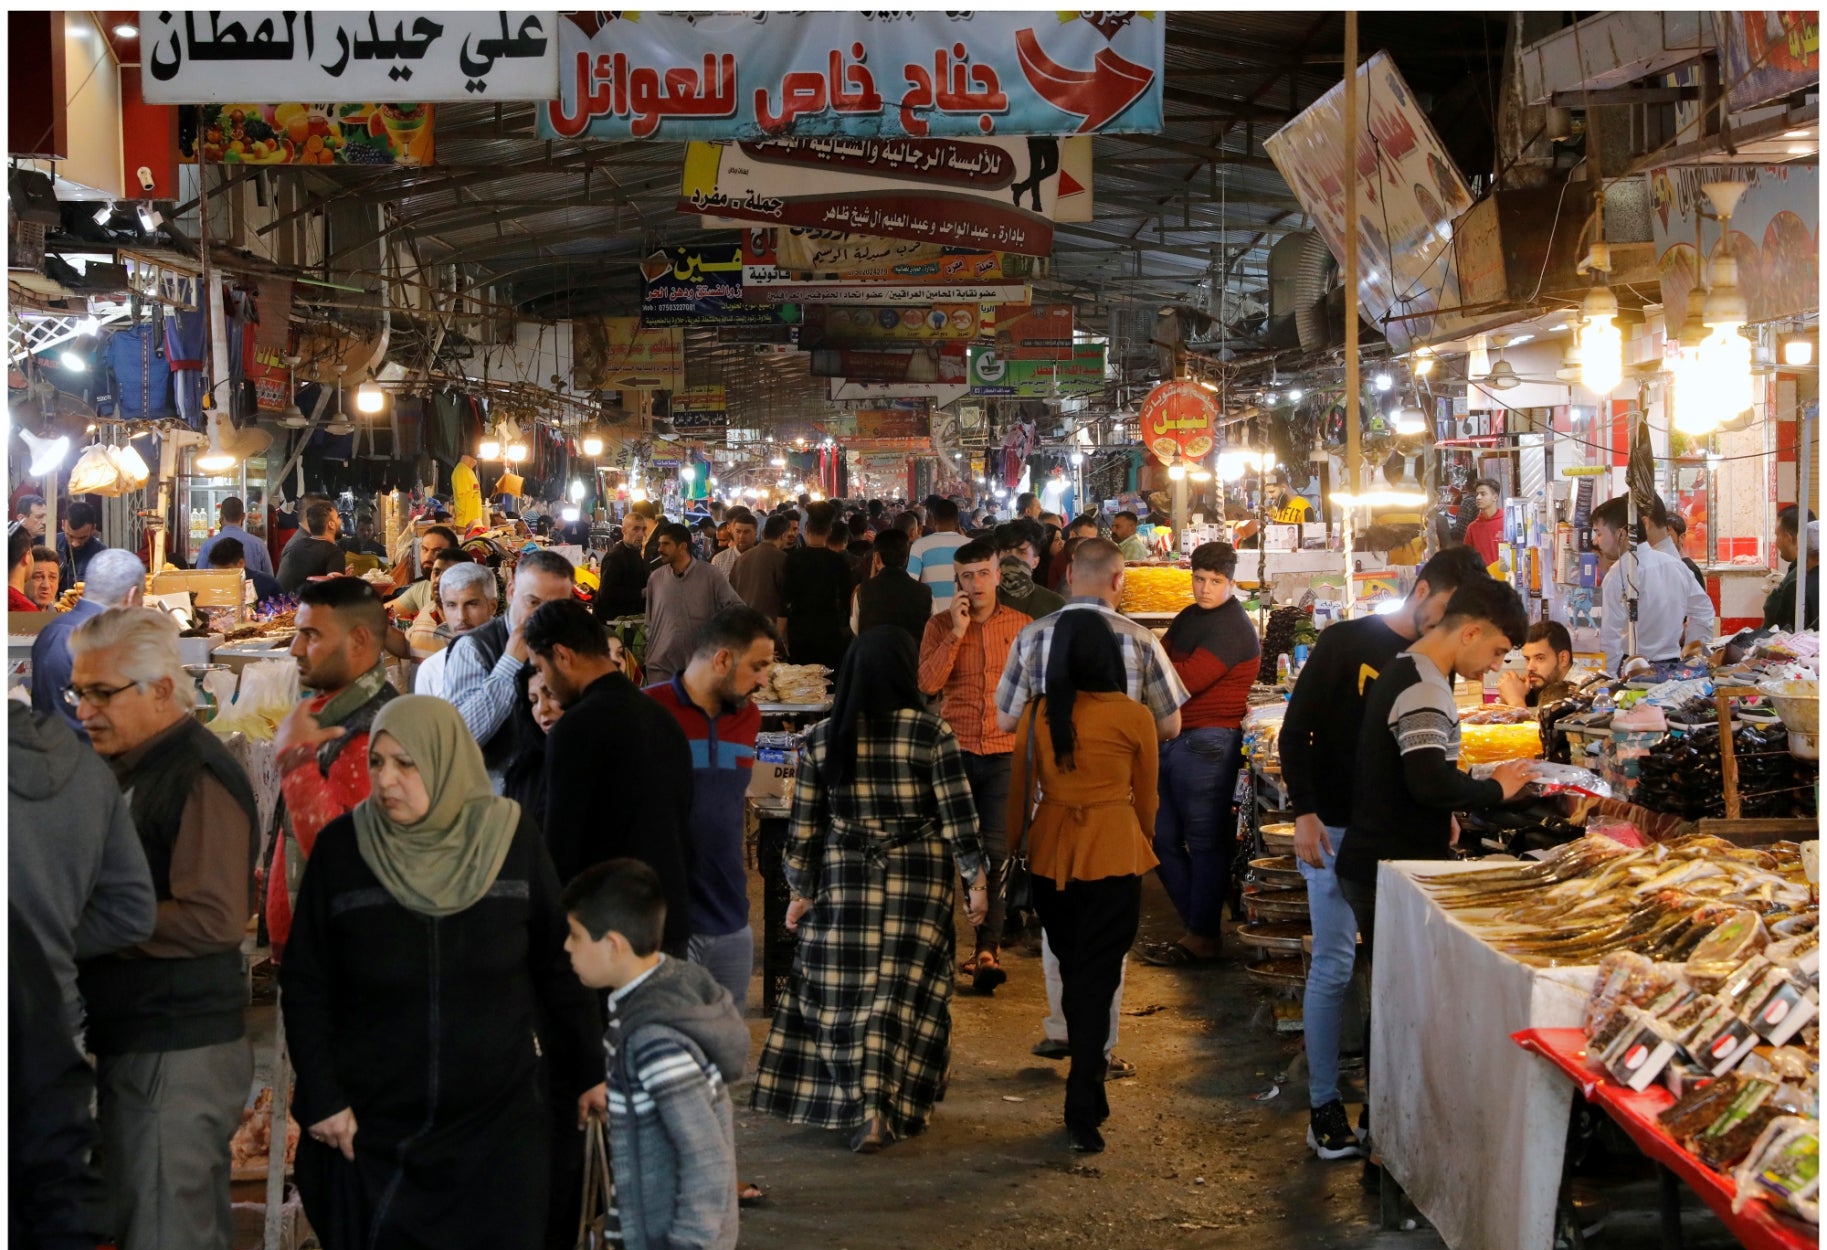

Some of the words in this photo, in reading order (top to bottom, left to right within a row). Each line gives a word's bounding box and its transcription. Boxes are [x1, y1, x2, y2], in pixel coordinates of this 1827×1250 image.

[321, 11, 443, 81] حيدر
[460, 11, 547, 93] علي
[549, 51, 736, 137] للعوائل
[753, 42, 882, 136] خاص
[900, 42, 1007, 134] جناح
[882, 143, 944, 169] الرجالية
[948, 149, 1002, 175] للألبسة
[691, 187, 728, 208] مفرد
[745, 190, 782, 215] جملة
[823, 208, 848, 225] ظاهر
[939, 216, 969, 239] الواحد
[971, 221, 989, 238] عبد
[926, 288, 956, 299] المحامين
[957, 288, 976, 299] نقابة
[977, 289, 996, 299] عضو
[1153, 407, 1209, 435] نبيل
